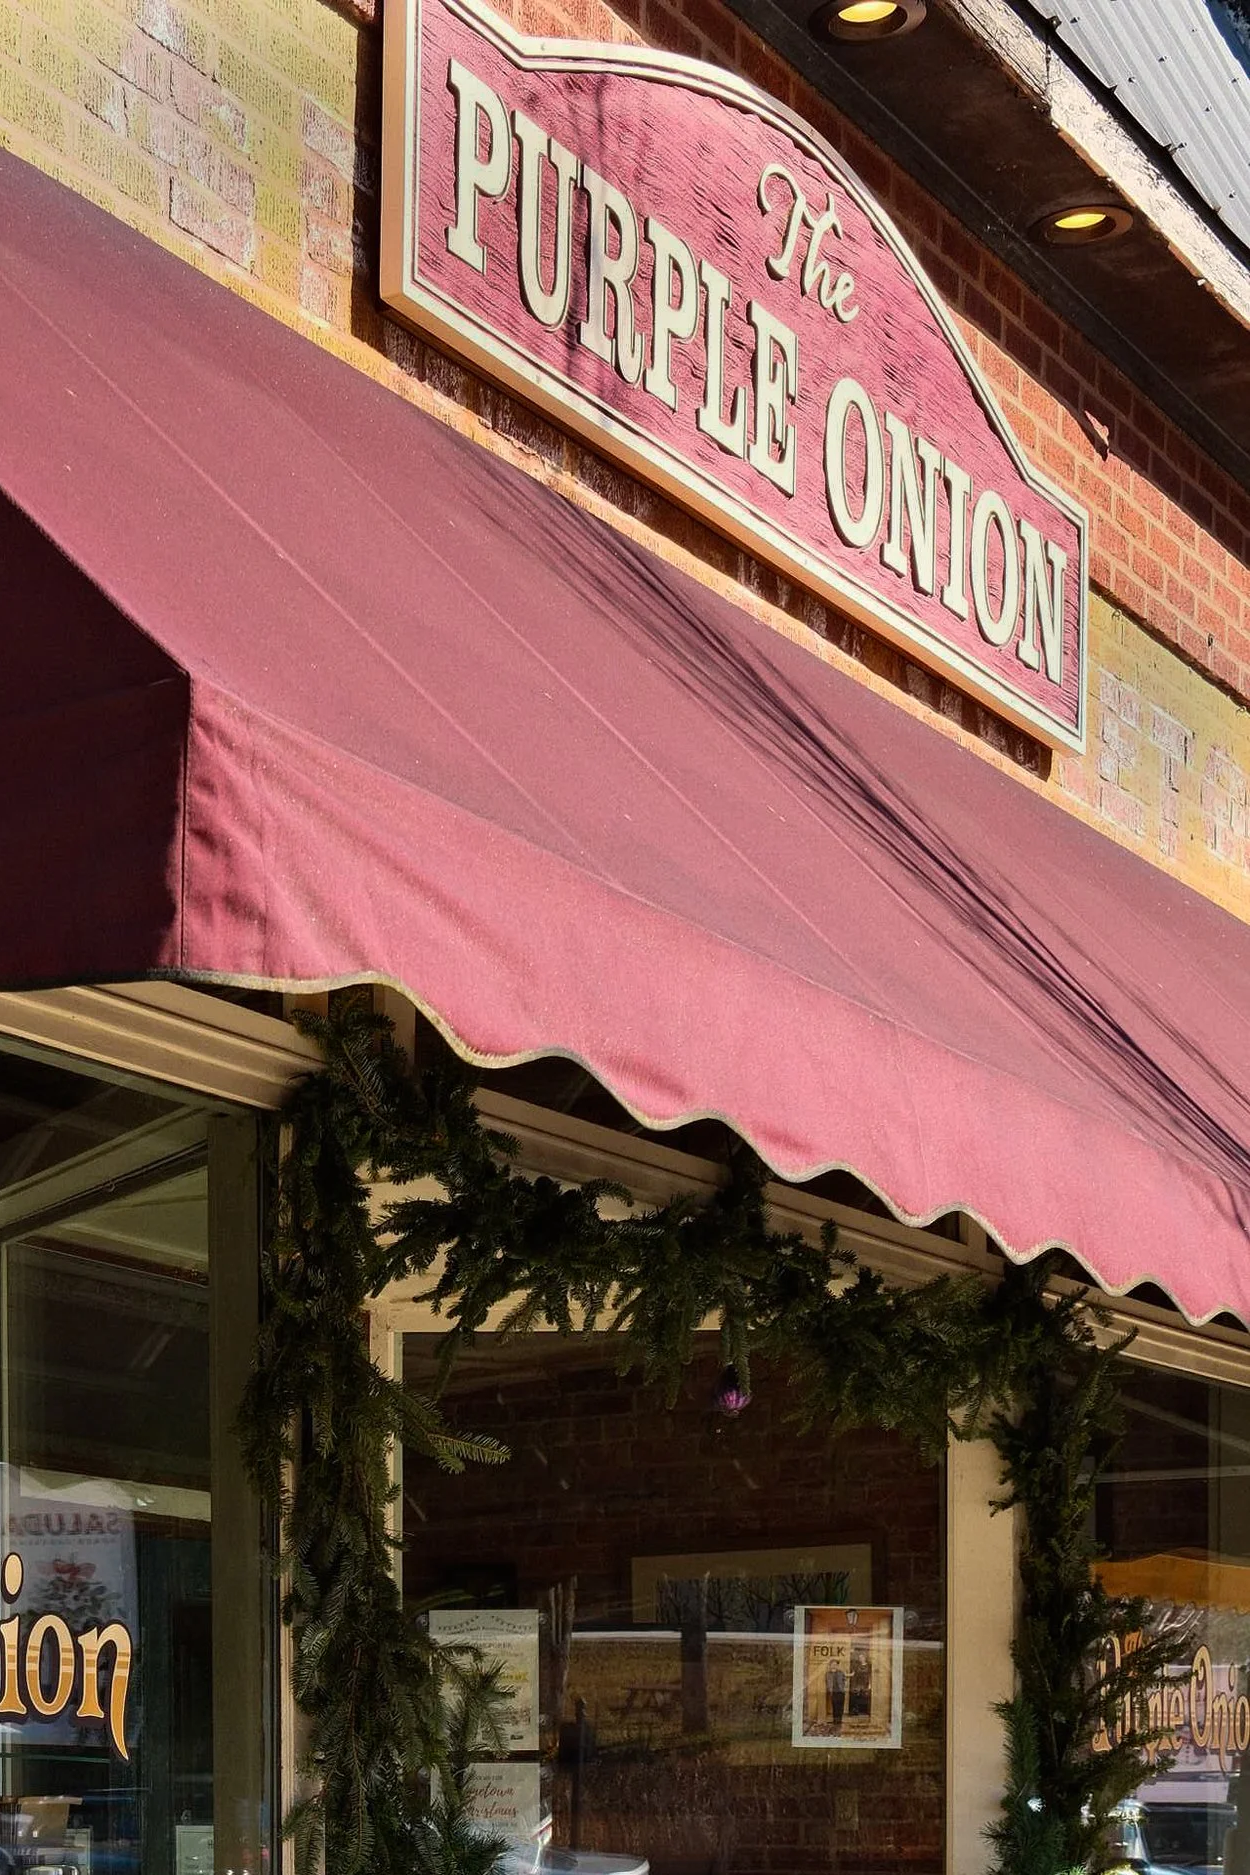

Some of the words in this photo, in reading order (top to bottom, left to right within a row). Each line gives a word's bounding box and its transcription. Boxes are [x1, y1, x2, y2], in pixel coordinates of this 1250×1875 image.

[758, 162, 861, 324] The
[447, 58, 799, 499] PURPLE
[823, 376, 1067, 688] ONION
[813, 1645, 846, 1657] FOLK
